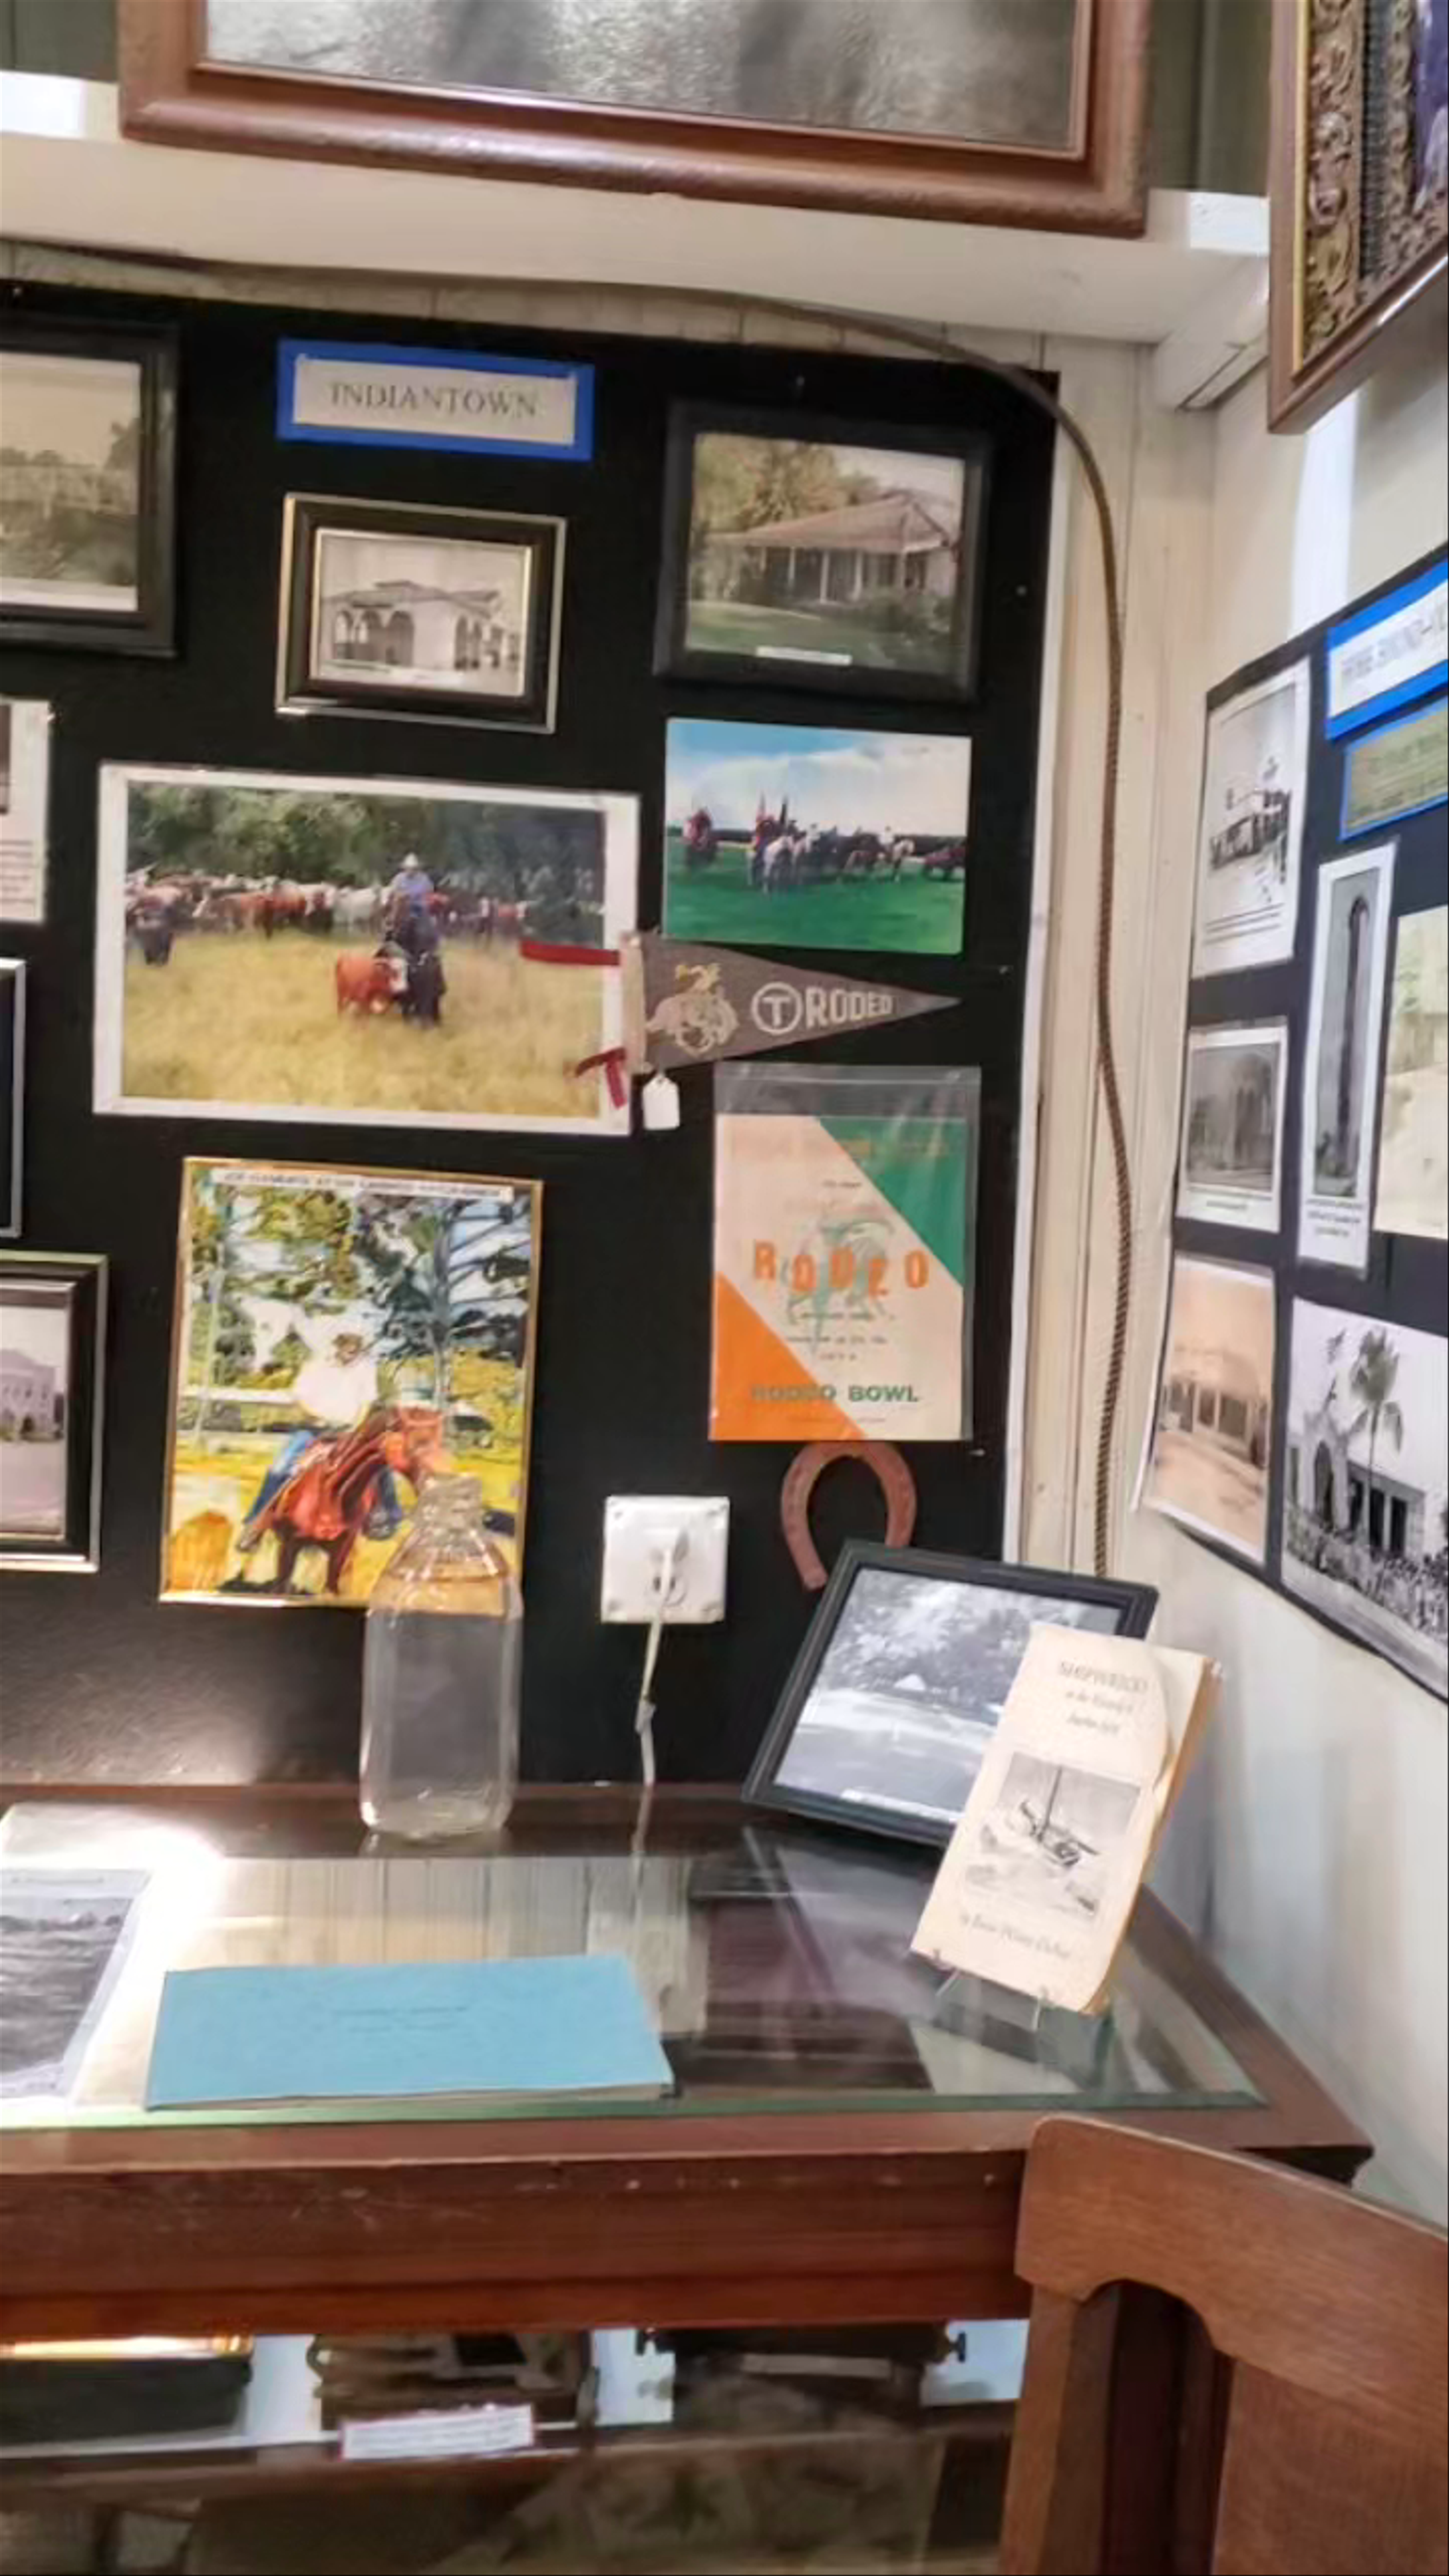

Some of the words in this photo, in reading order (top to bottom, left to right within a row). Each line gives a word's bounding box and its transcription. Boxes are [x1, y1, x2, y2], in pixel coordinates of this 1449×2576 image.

[331, 381, 538, 417] INDIANTOWN
[806, 986, 893, 1029] RODEO
[754, 1240, 929, 1301] RODEO
[849, 1384, 919, 1403] BOWL
